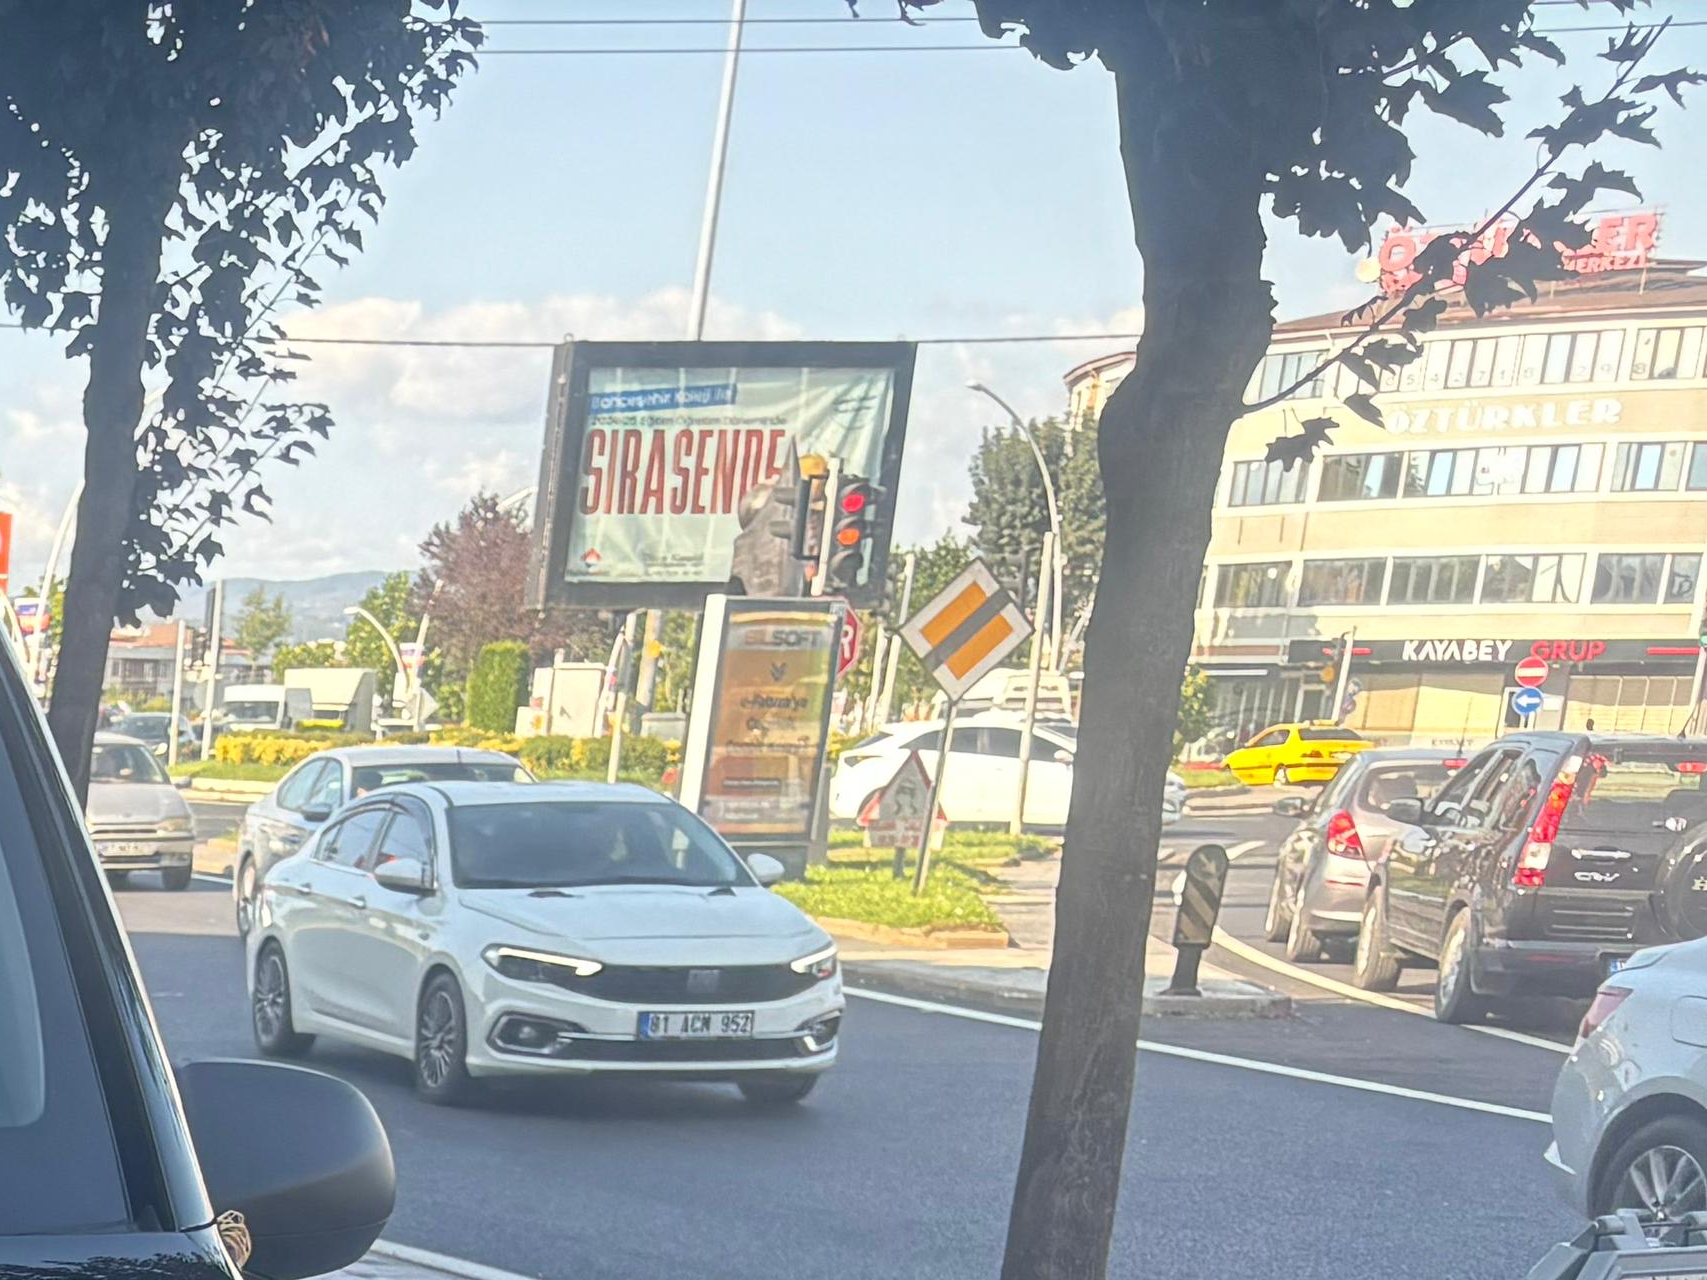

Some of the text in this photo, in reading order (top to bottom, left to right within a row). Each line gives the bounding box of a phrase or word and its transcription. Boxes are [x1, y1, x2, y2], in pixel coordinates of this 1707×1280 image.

[1387, 400, 1622, 434] ÖZTÜRKLER
[1402, 640, 1607, 662] KAYABEY GRUP
